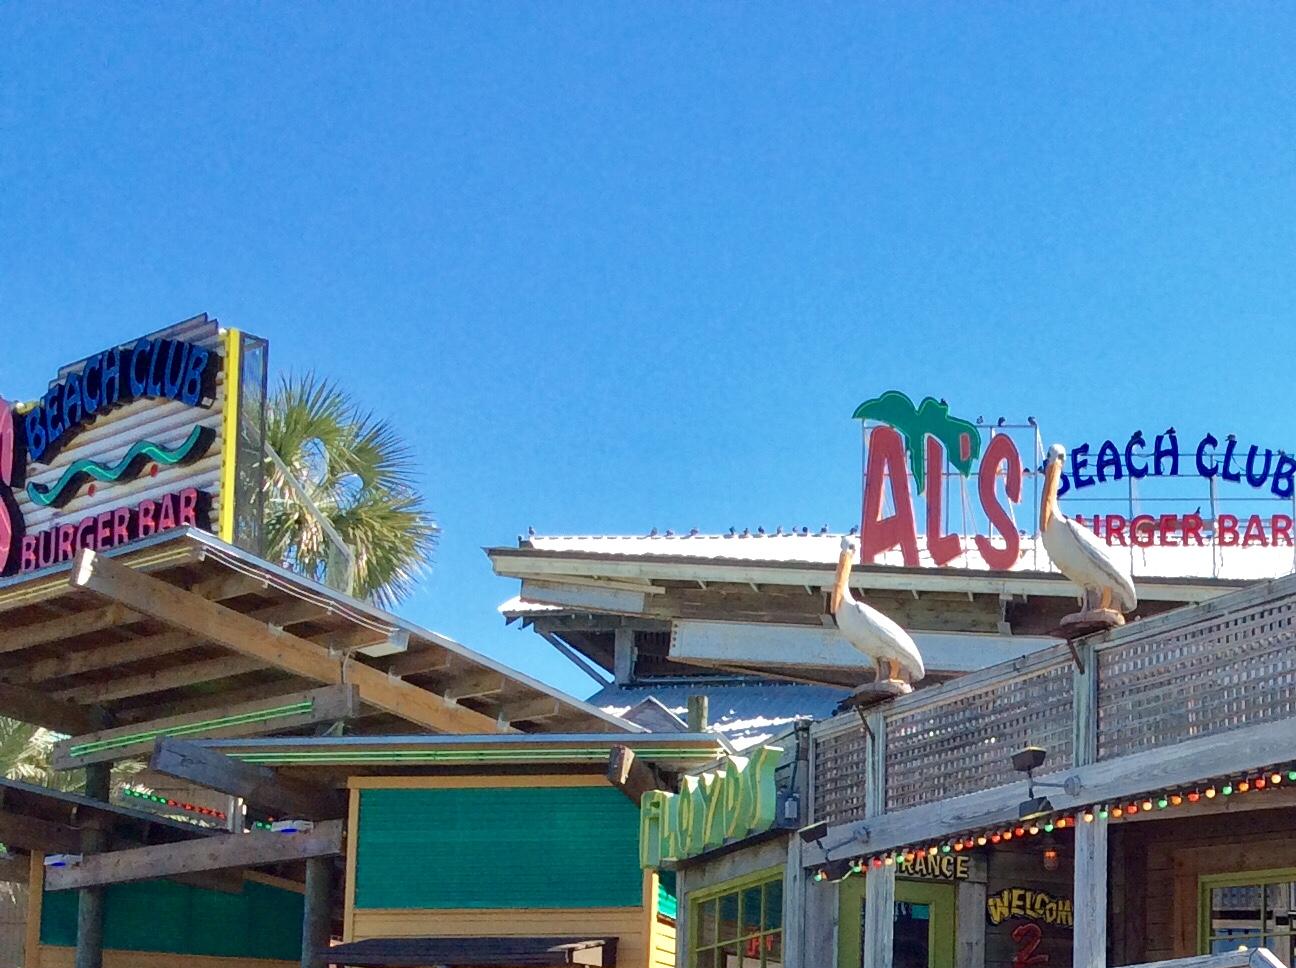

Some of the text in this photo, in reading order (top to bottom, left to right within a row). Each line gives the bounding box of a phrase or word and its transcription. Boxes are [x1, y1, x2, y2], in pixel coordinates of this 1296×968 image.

[25, 337, 211, 461] BEACH CLUB
[1043, 433, 1180, 498] EACH
[21, 487, 199, 573] BURGER BAR
[1076, 513, 1295, 548] RGER BAR
[900, 853, 970, 879] RANCE
[987, 887, 1074, 927] WELCOM
